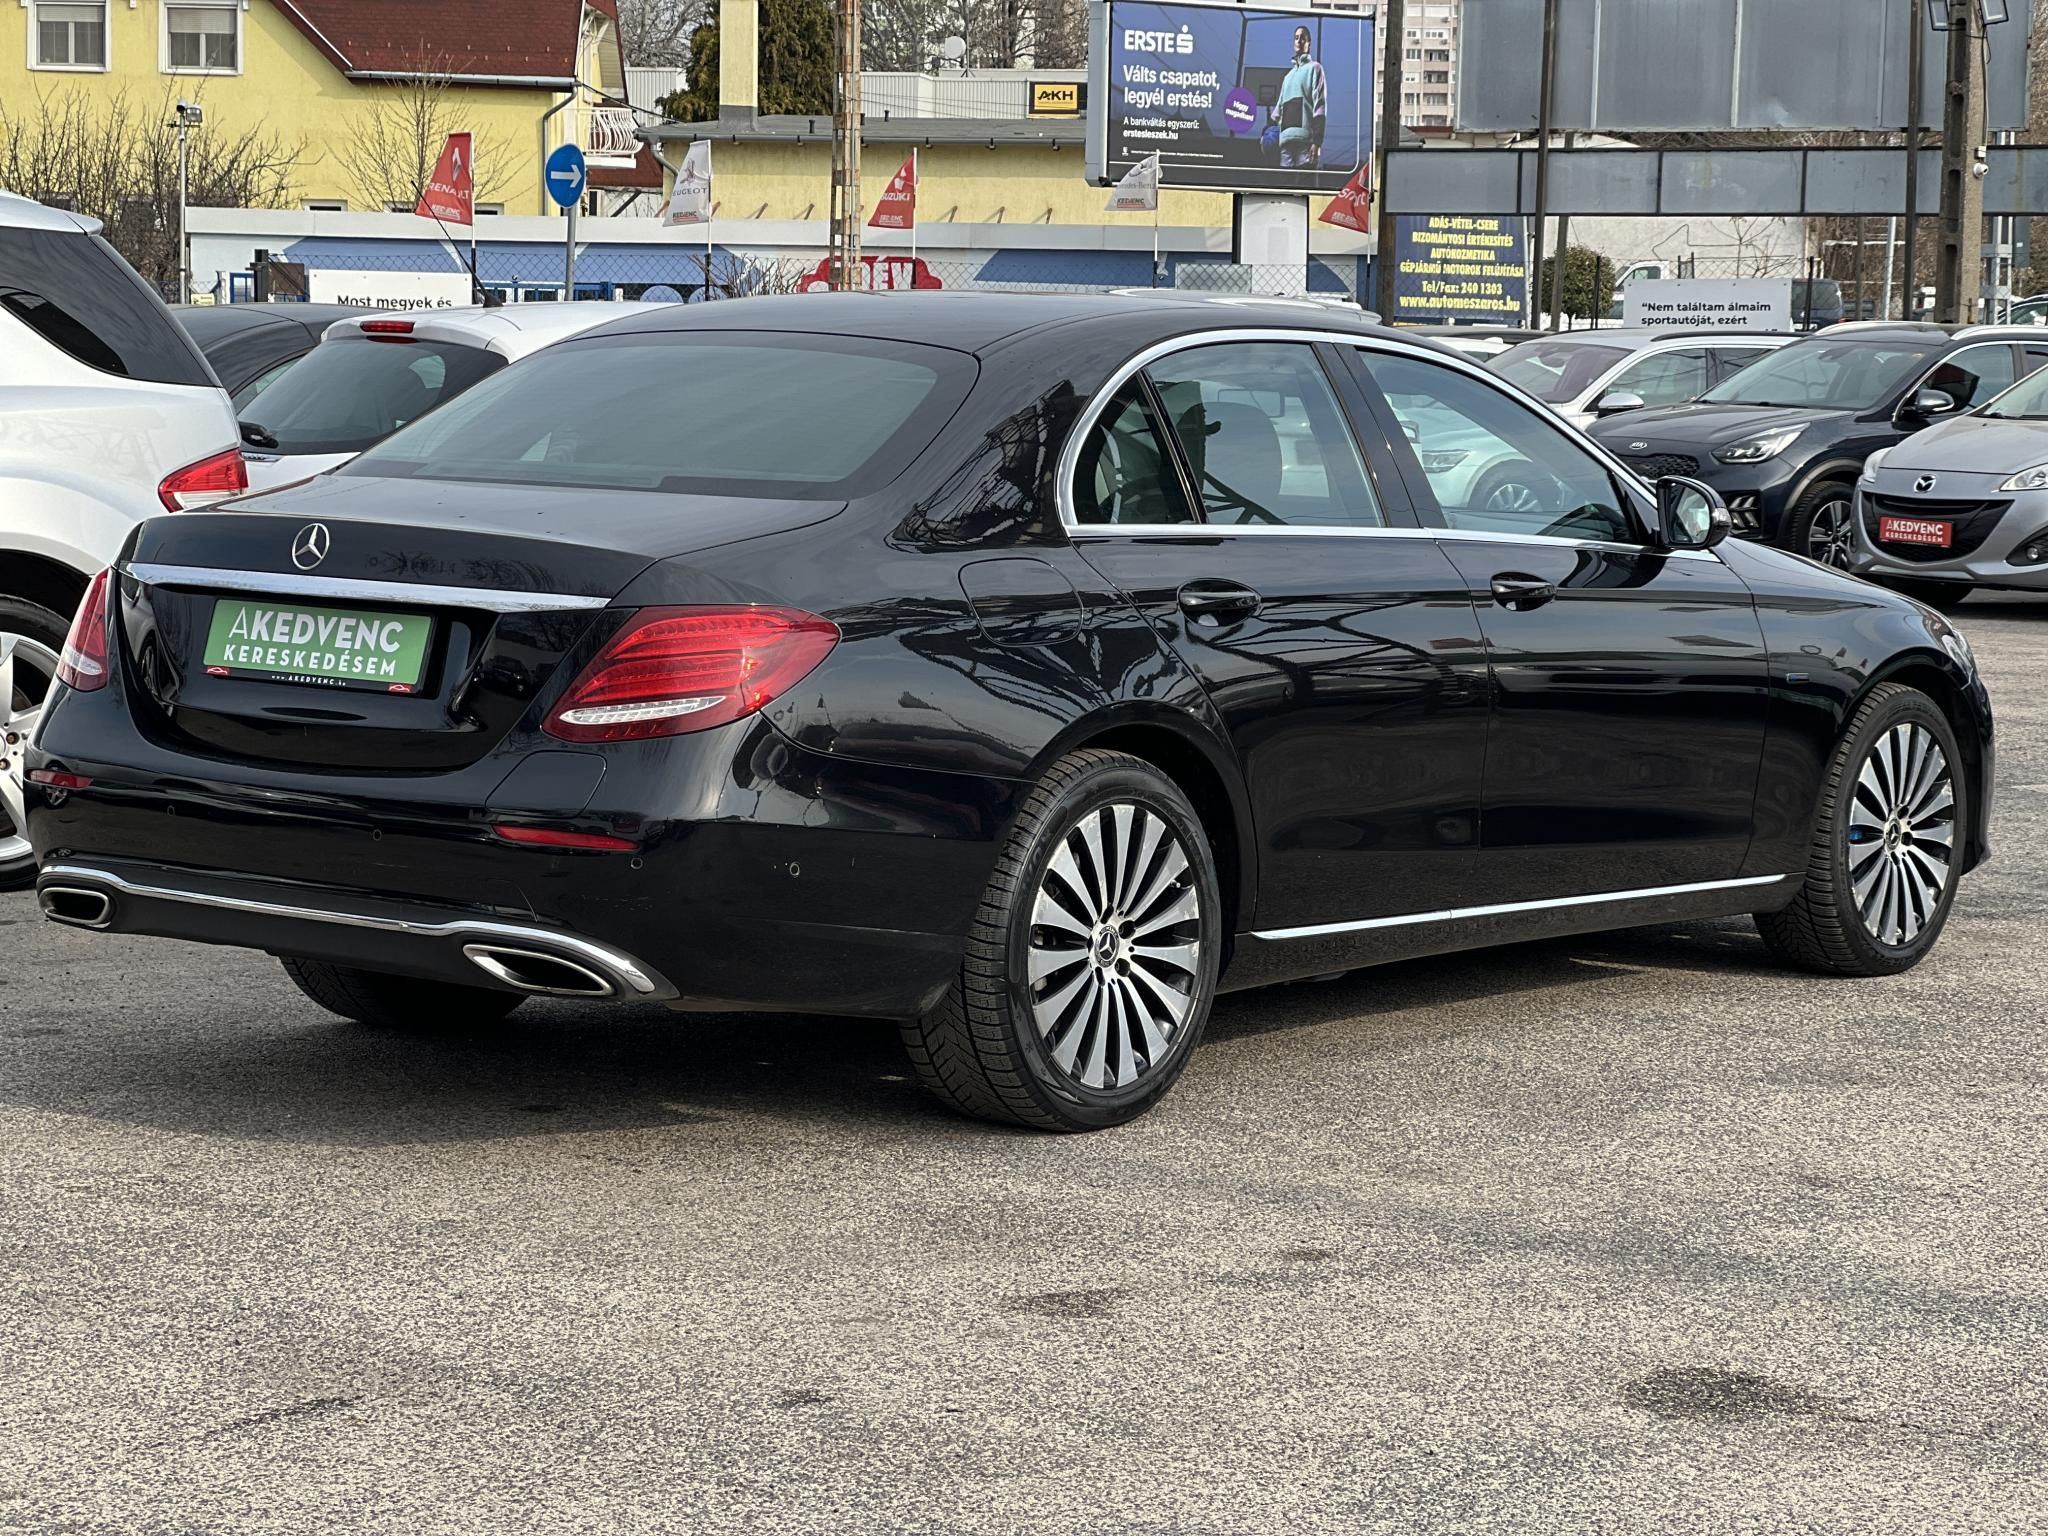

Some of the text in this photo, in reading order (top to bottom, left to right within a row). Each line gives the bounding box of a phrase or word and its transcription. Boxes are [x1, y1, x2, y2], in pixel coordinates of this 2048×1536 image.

[1124, 29, 1175, 53] ERSTE
[1123, 64, 1220, 90] Válts csapatot,
[1037, 90, 1073, 101] AKH
[1124, 86, 1212, 109] legyél erstés!
[1123, 116, 1129, 126] A
[1130, 117, 1166, 128] bankváltás
[1429, 216, 1499, 231] ADÁS-VÉTEL-CSERE
[1412, 231, 1466, 245] BIZOMÁNYOSI
[1430, 246, 1496, 260] AUTÓKOZMETIKA
[1442, 264, 1481, 275] MOTOROK
[1422, 281, 1503, 295] Tel/Fax: 240 1303
[337, 295, 452, 311] Most megyek és
[1676, 301, 1725, 312] találtam
[1727, 301, 1771, 312] álmaim
[1641, 314, 1748, 327] sportautóját, ezért
[1886, 520, 1944, 535] AKEDVENC
[228, 606, 404, 653] AKEDVENC
[223, 643, 397, 677] KERESKEDÉSEM
